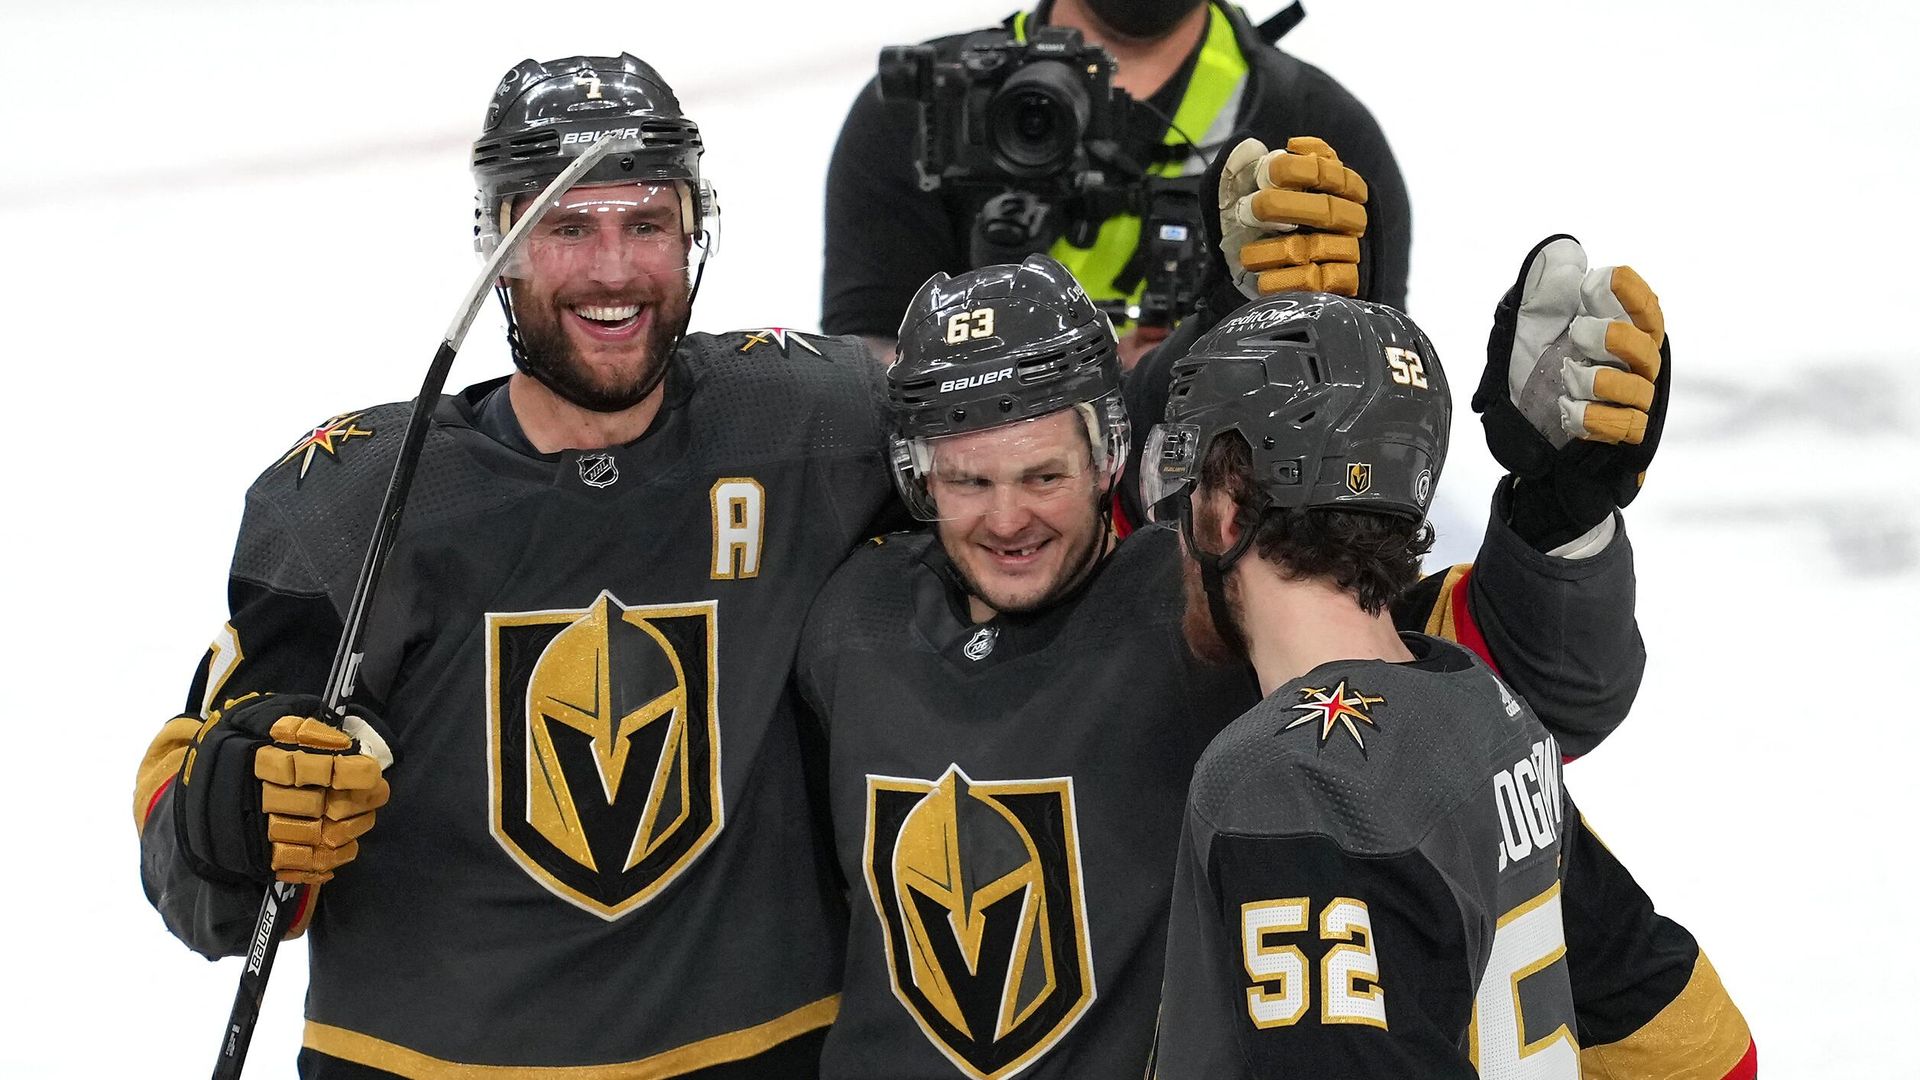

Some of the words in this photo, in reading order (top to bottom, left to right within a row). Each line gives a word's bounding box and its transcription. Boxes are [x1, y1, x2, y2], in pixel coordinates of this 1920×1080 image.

[562, 128, 639, 144] BAUR
[947, 307, 994, 345] 63
[940, 368, 1014, 393] BAUER
[1384, 346, 1428, 389] 52
[709, 477, 766, 580] A
[252, 910, 273, 968] BAUER
[1241, 896, 1388, 1031] 52
